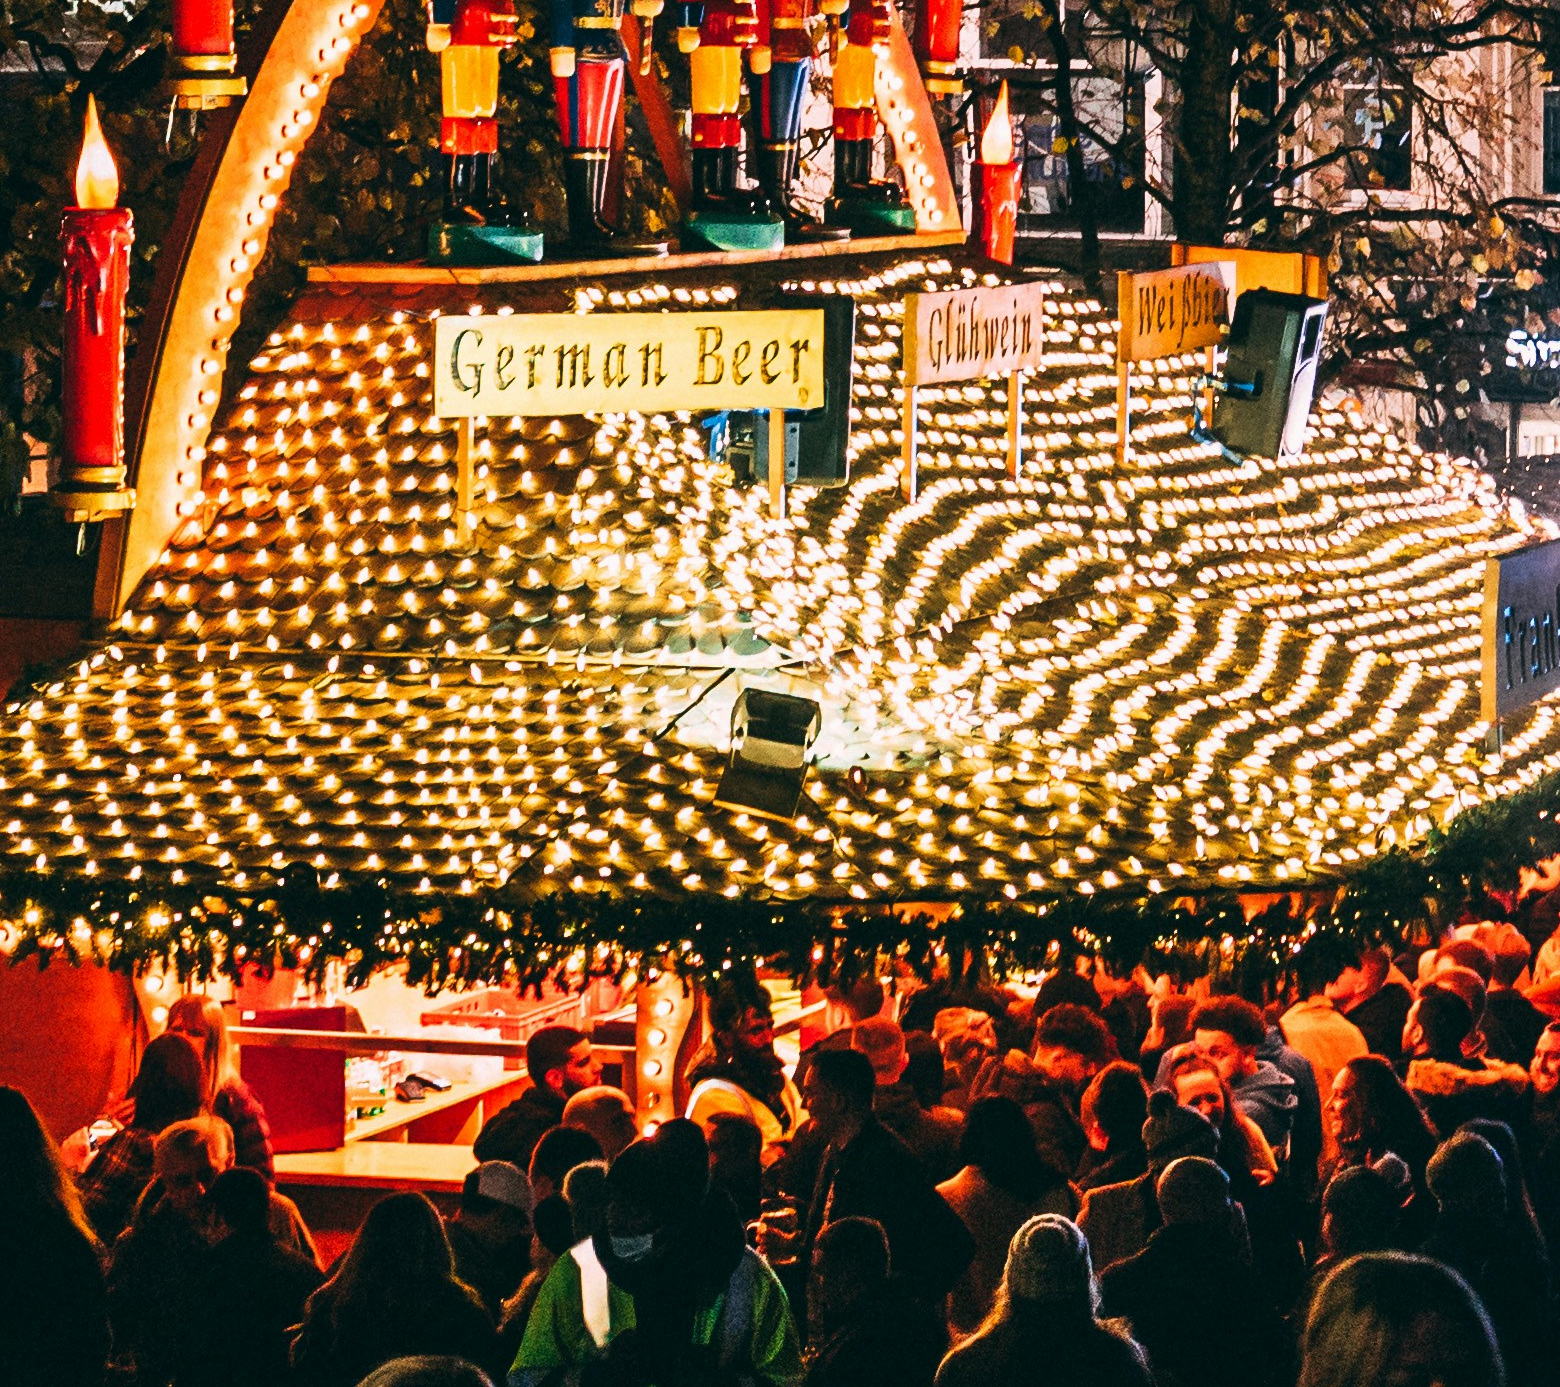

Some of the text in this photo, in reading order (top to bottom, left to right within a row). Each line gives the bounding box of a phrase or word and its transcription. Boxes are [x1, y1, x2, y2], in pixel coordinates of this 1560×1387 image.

[449, 325, 810, 399] German Beer
[928, 295, 1033, 371] Glühwein
